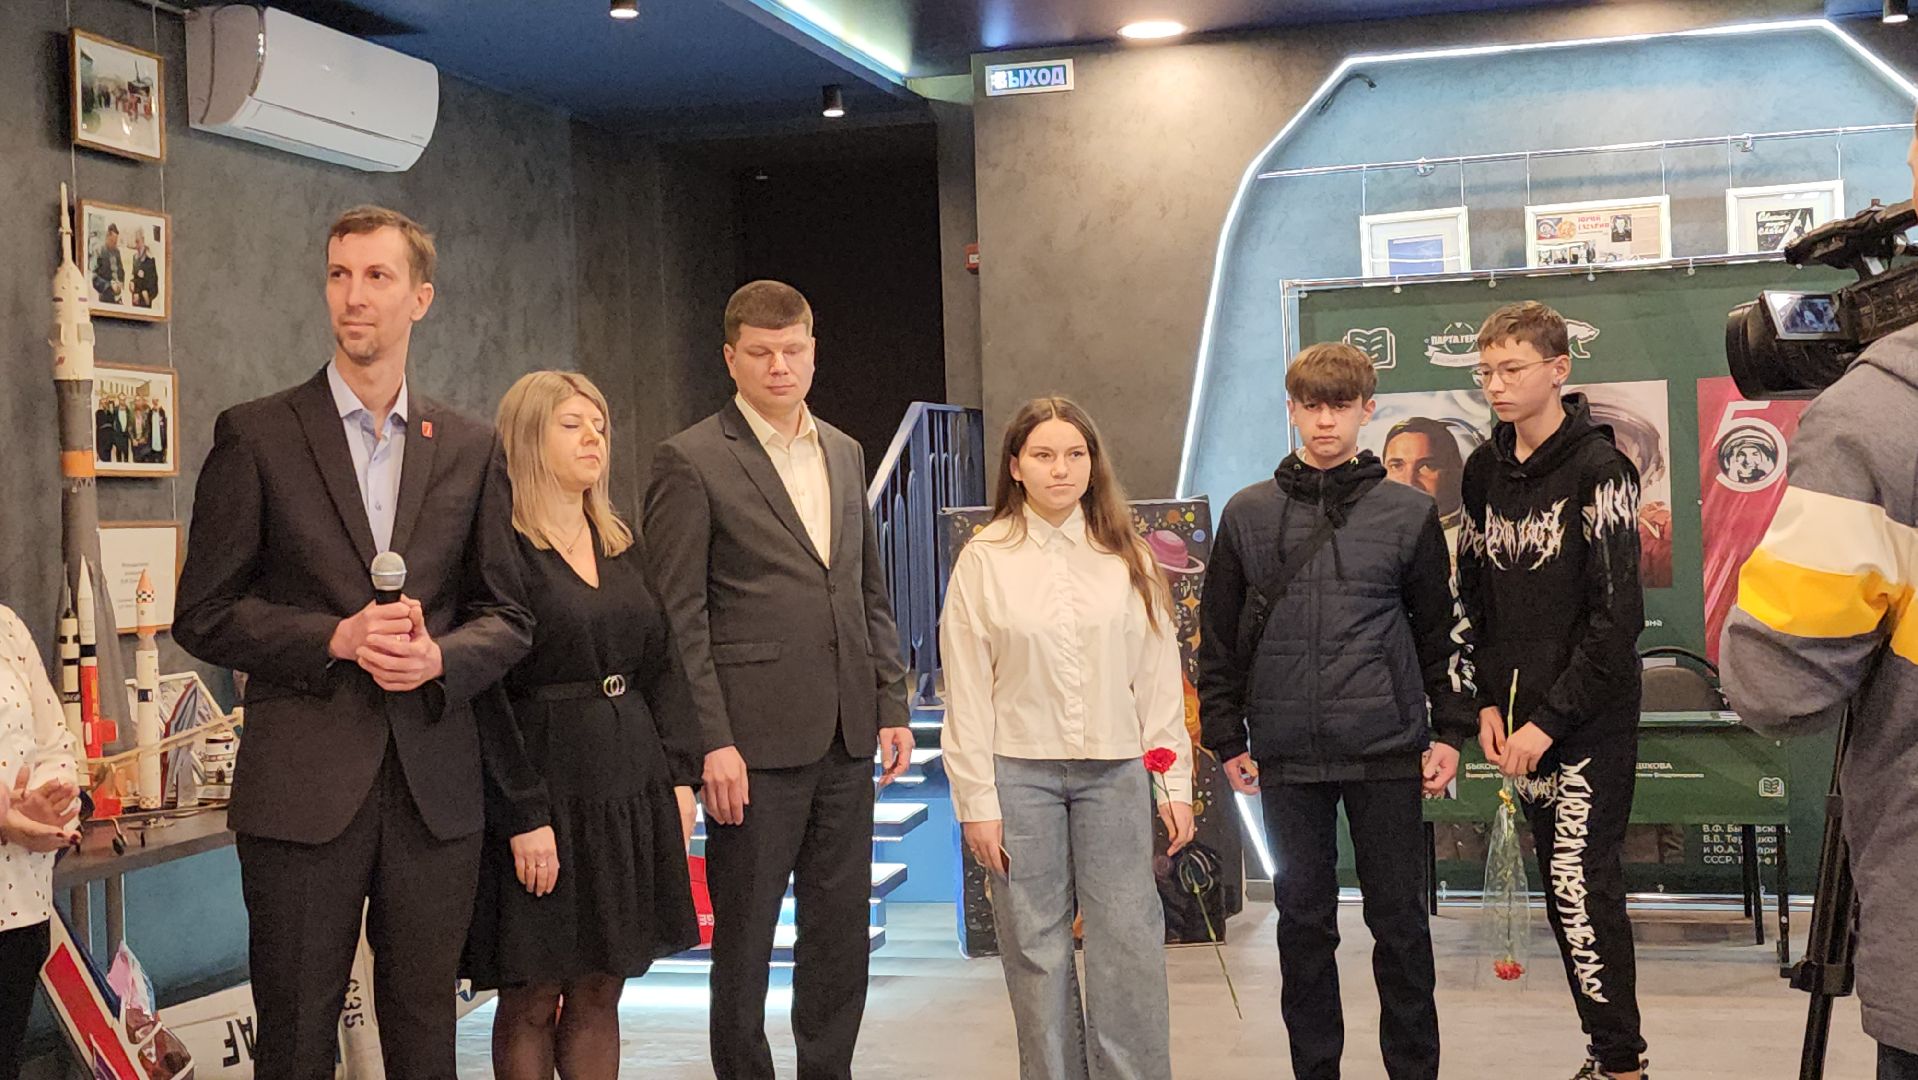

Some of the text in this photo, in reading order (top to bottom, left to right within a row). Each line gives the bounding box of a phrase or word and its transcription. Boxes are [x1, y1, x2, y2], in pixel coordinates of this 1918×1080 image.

[992, 66, 1066, 90] ВЫХОД
[1713, 844, 1738, 854] Ю.А.
[1703, 855, 1735, 865] СССР.
